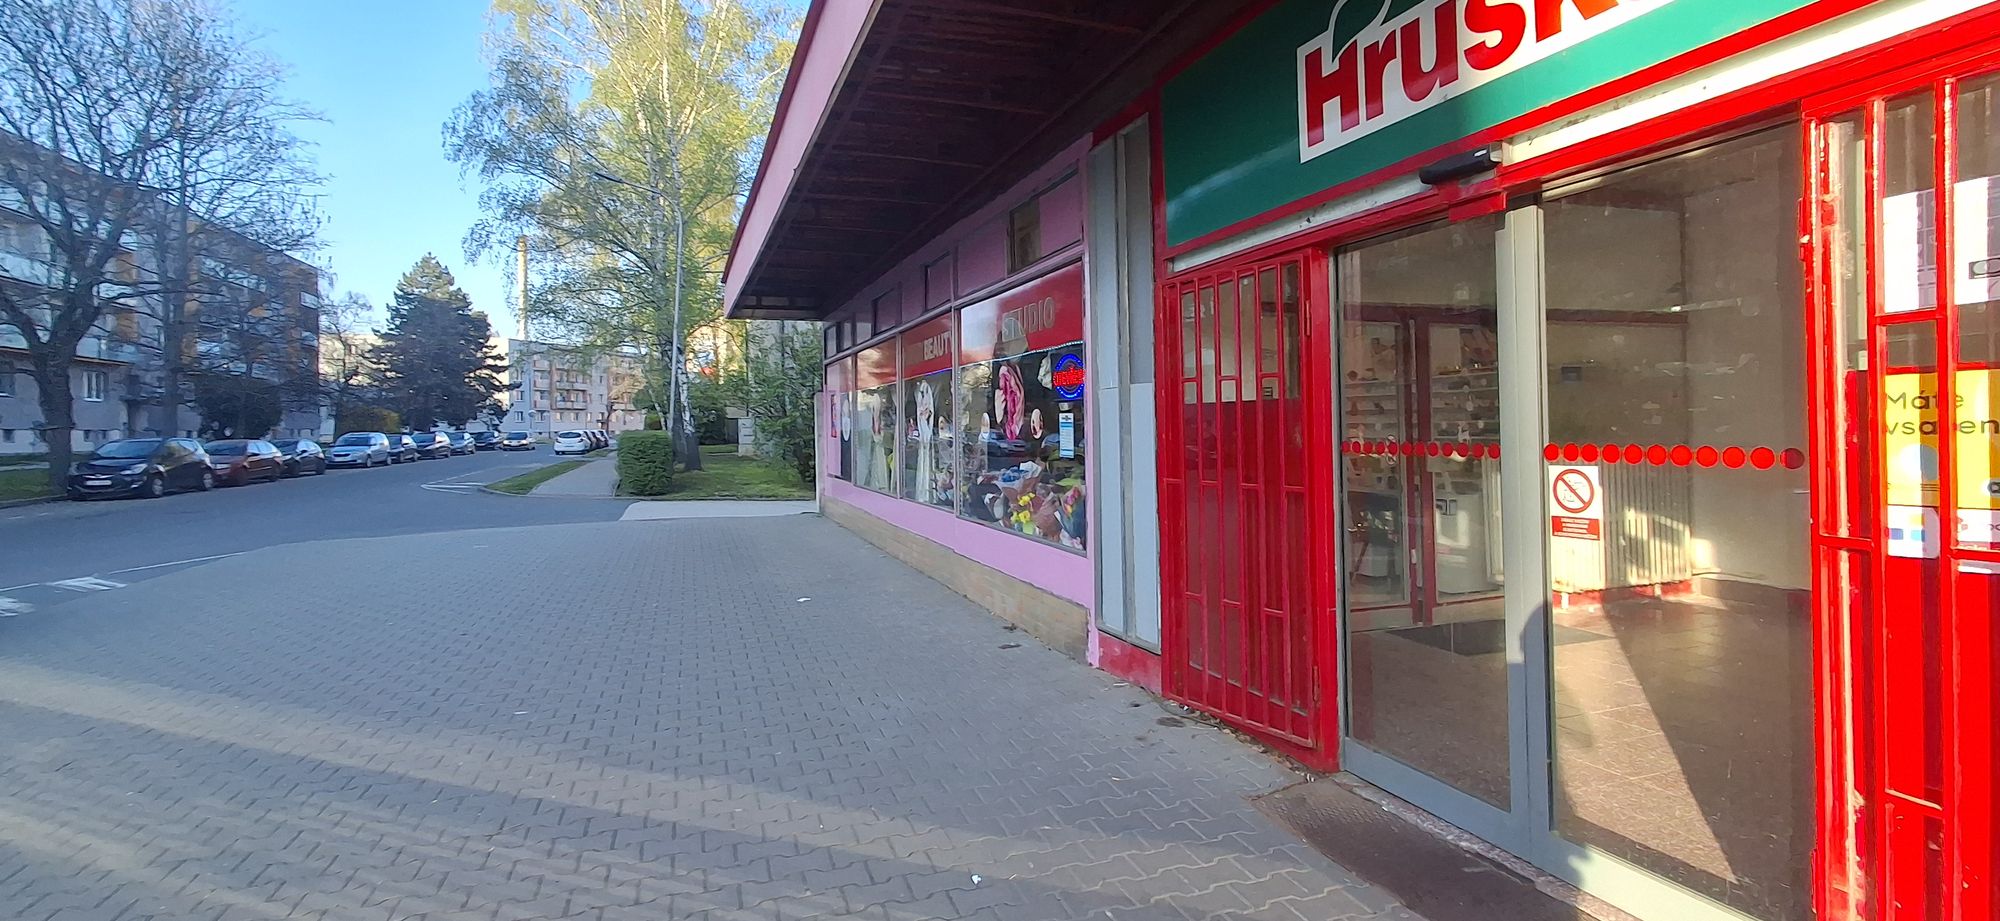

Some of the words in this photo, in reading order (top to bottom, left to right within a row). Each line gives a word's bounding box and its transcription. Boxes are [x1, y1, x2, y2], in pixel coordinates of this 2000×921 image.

[1002, 297, 1055, 342] STUDIO
[1886, 389, 1964, 410] Máe
[1886, 419, 2000, 435] vsaen
